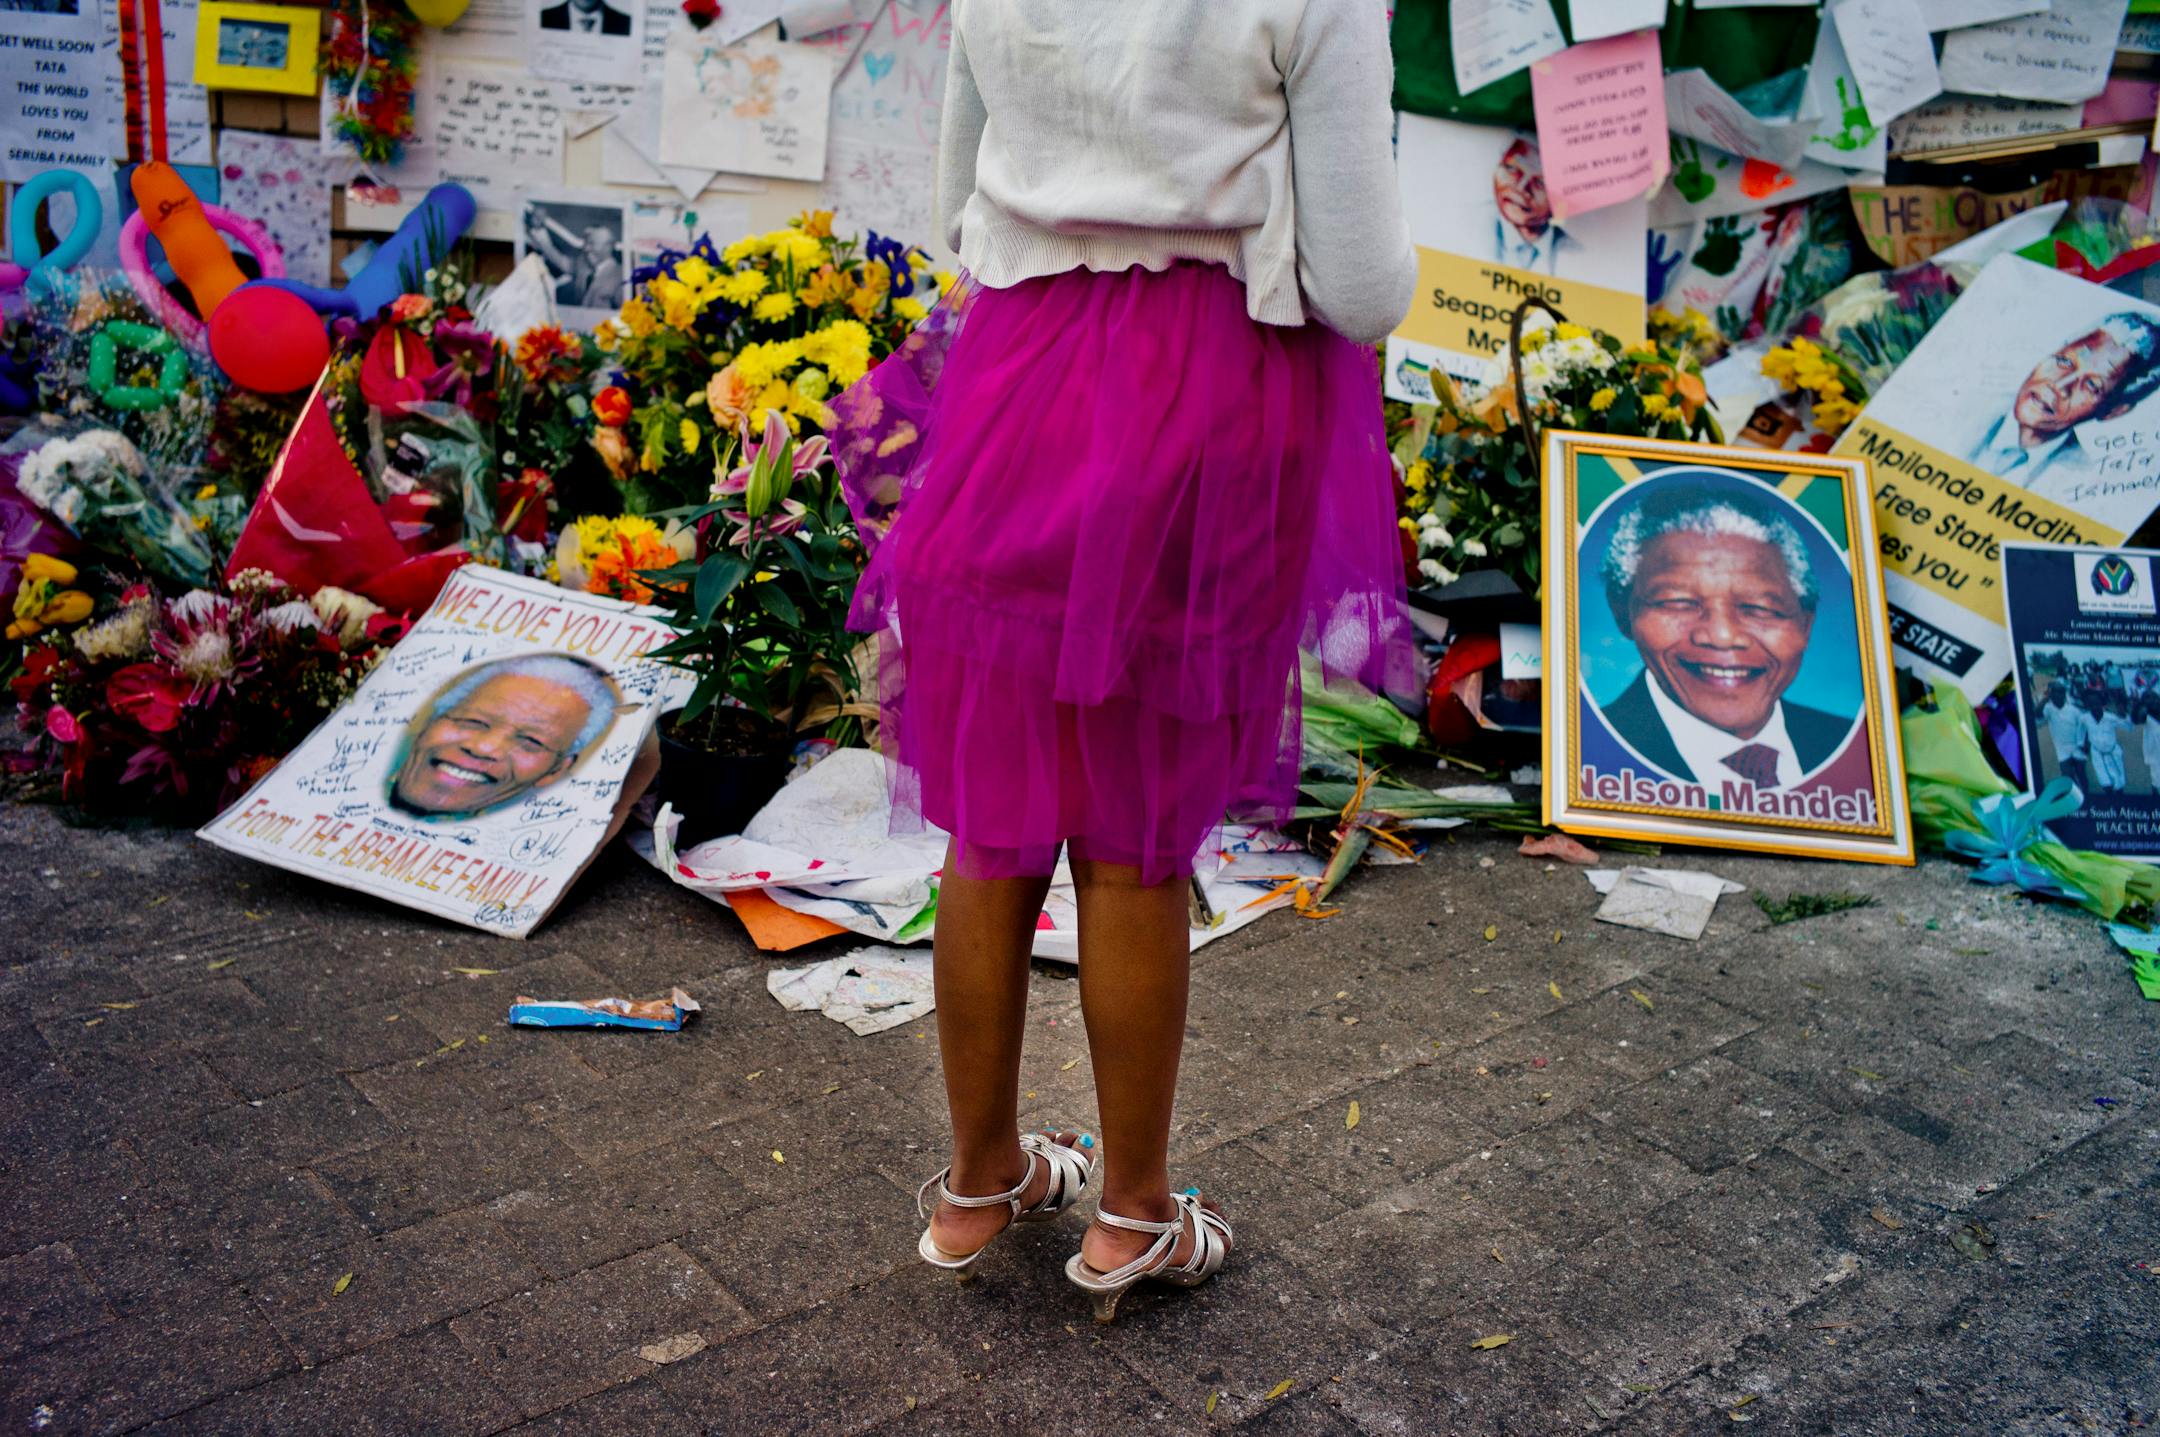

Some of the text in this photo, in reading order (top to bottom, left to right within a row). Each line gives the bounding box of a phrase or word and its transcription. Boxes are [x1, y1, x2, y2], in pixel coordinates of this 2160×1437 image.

[22, 37, 55, 51] WELL
[58, 40, 95, 54] SOON
[34, 61, 67, 74] TATA
[17, 82, 89, 99] THE WORLD
[21, 105, 89, 121] LOVES YOU
[36, 128, 76, 142] FROM
[8, 150, 106, 167] SERUBA FAMILY
[1853, 190, 1922, 235] THE
[1874, 482, 2001, 562] Free State
[1911, 551, 1970, 591] you
[433, 580, 492, 625] WE
[474, 592, 562, 644] LOVE
[551, 608, 622, 657] YOU
[1903, 622, 1963, 665] STATE
[1580, 767, 1879, 824] Nelson Mandel
[2089, 802, 2117, 818] South
[289, 813, 356, 858] THE
[444, 858, 550, 912] FAMILY
